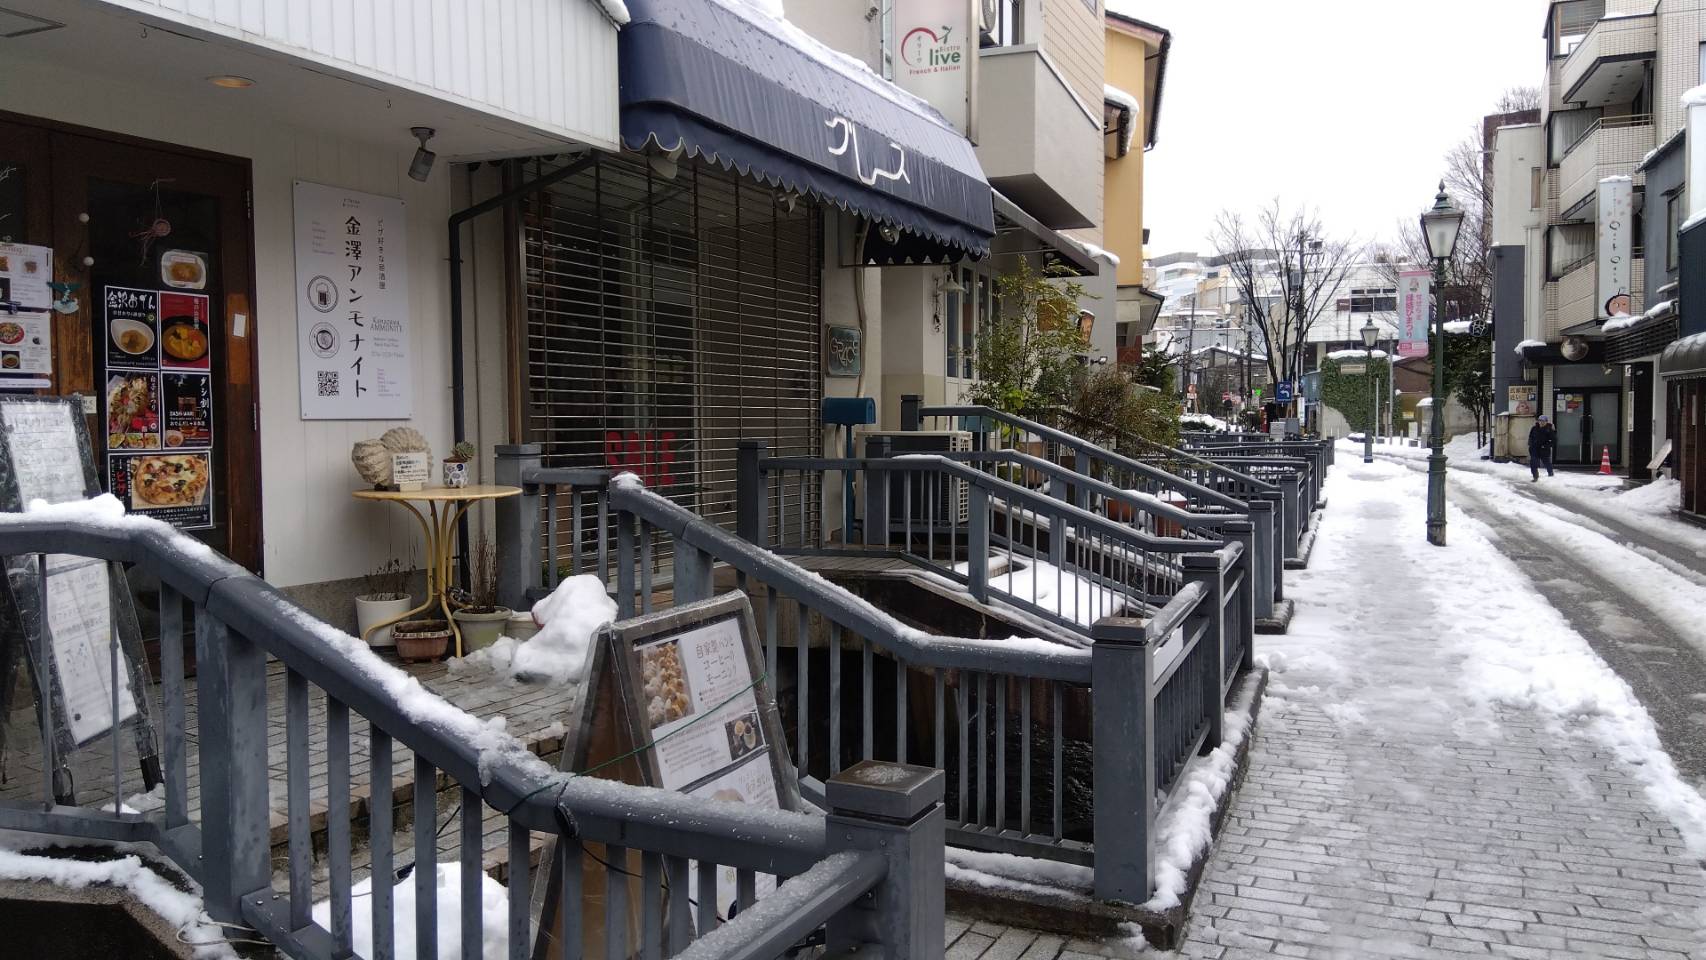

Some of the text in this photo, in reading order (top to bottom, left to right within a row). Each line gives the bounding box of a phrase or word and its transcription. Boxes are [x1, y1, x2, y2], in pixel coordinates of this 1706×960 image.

[929, 48, 961, 66] live
[940, 65, 961, 73] Italian
[107, 290, 156, 310] 金沢おでん
[344, 216, 367, 398] 金澤アンモナイト
